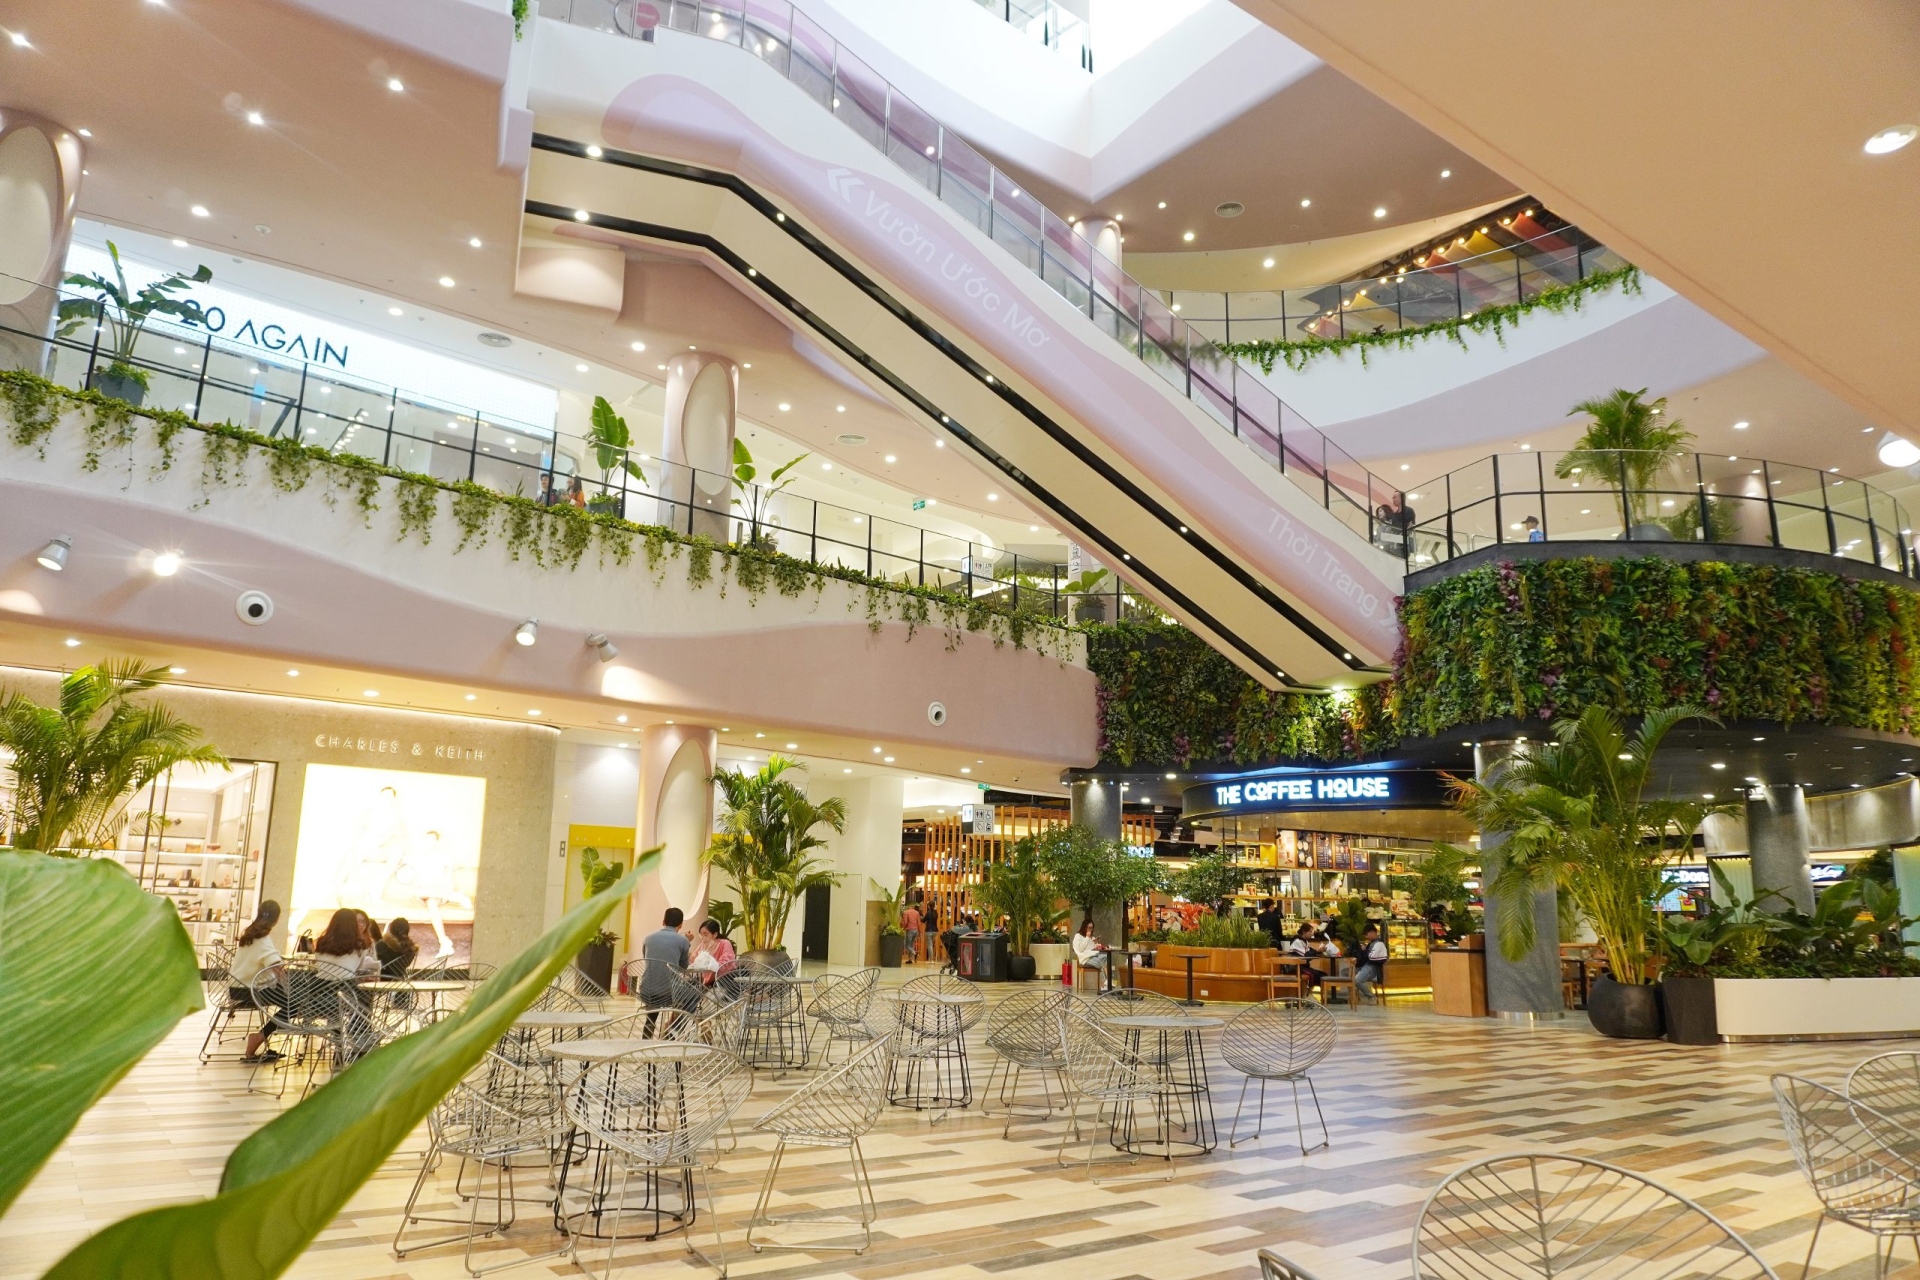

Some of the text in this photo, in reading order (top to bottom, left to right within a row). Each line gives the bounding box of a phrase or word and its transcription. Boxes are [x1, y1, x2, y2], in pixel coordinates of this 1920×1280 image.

[864, 189, 1051, 348] Vườn Ước Mơ
[234, 319, 349, 368] AGAIN
[1267, 507, 1379, 617] Thời Trang
[315, 733, 485, 761] CHARLES & KEITH
[1216, 777, 1390, 805] THE COFFEE HOUSE
